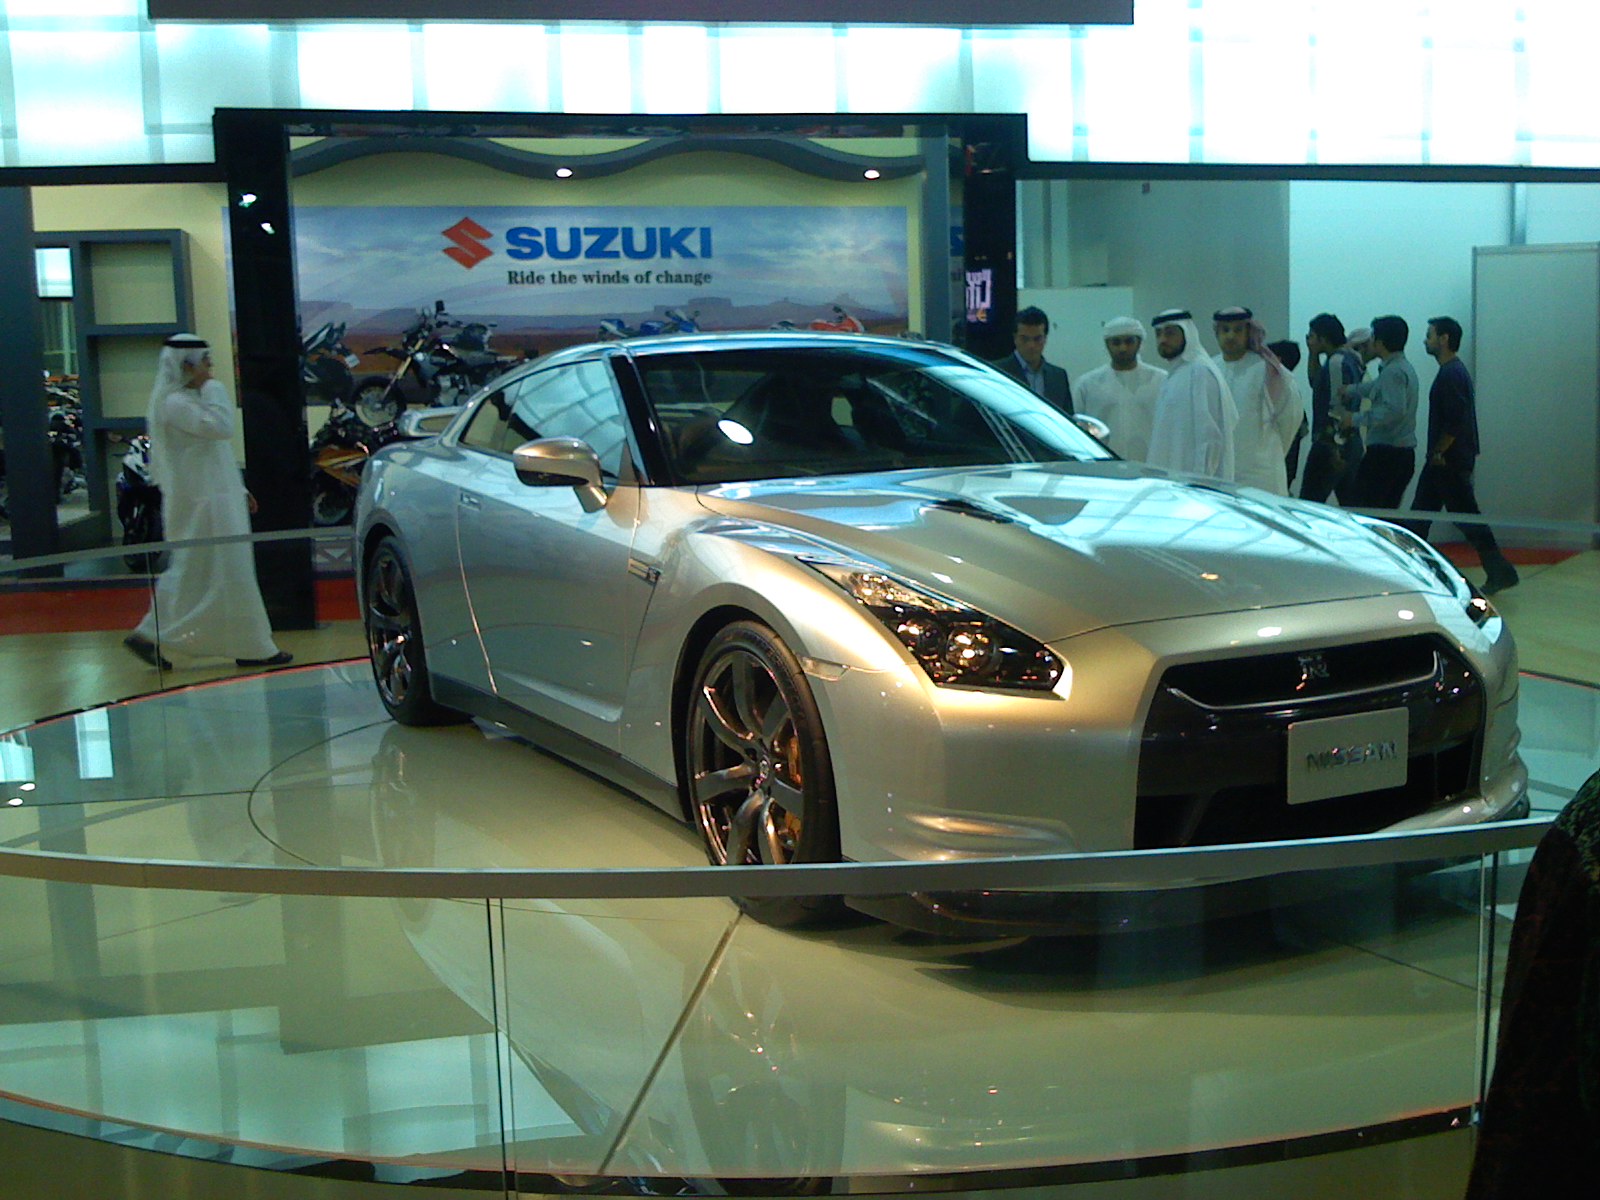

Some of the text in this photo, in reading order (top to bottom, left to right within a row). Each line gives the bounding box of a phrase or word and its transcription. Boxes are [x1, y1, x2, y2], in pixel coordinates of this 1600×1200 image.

[505, 226, 712, 260] SUZUKI
[507, 271, 712, 287] Ride the winds of change
